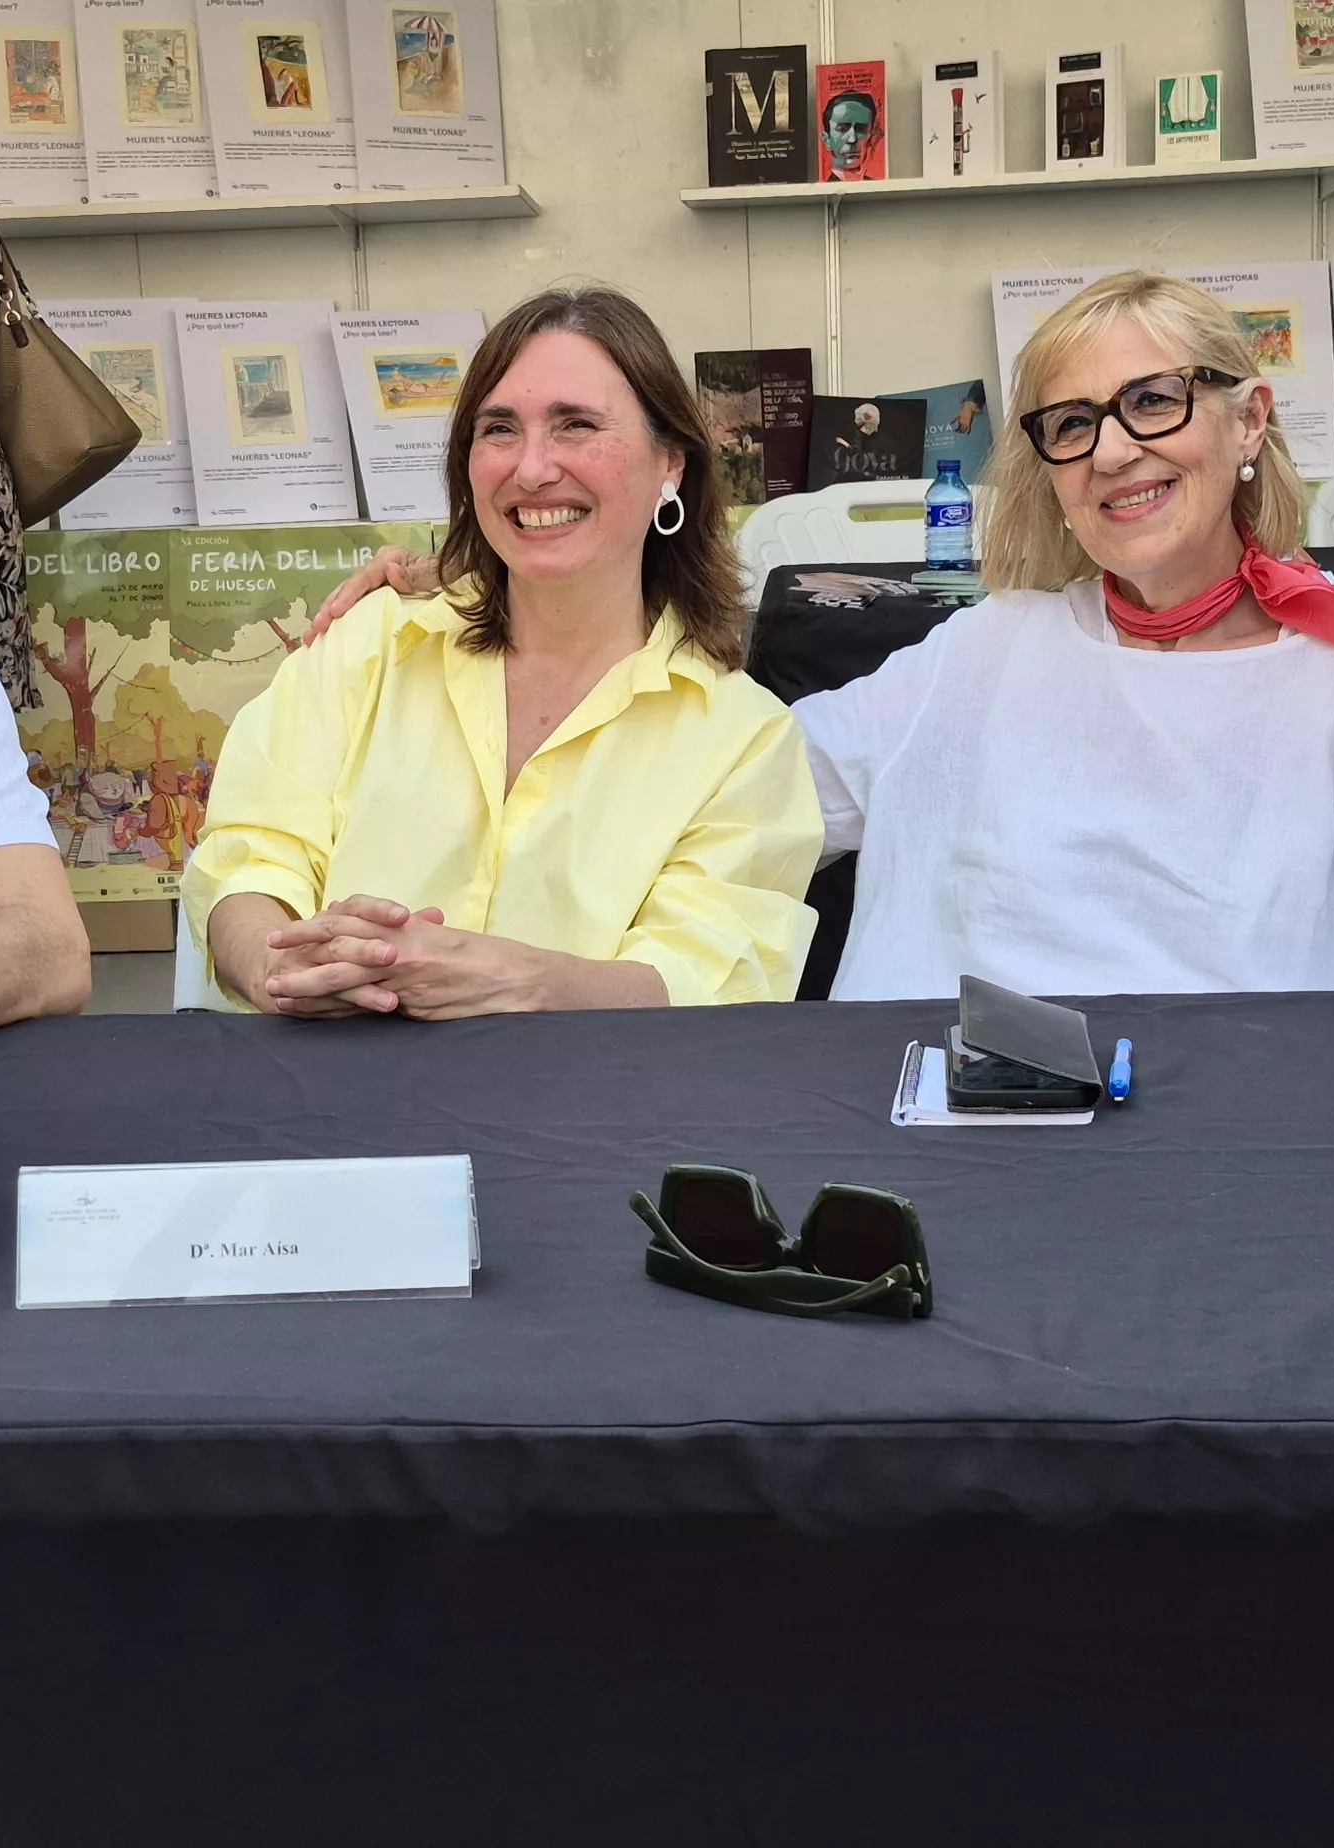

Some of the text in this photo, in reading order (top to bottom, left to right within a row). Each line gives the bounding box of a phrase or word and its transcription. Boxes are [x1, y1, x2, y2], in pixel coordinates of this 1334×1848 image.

[1293, 83, 1331, 92] MUJERES
[725, 70, 795, 135] M
[254, 130, 291, 138] MUJERES
[393, 126, 428, 136] MUJERES
[127, 136, 165, 144] MUJERES
[1002, 278, 1084, 288] MUJERES LECTORAS
[1215, 274, 1259, 283] LECTORAS
[89, 310, 132, 318] LECTORAS
[186, 311, 268, 320] MUJERES LECTORAS
[340, 321, 377, 329] MUJERES
[395, 442, 432, 450] MUJERES
[232, 454, 269, 462] MUJERES
[196, 537, 229, 545] EDICIÓN
[26, 551, 161, 576] DEL LIBRO
[191, 546, 373, 573] FERIA DEL LIB
[190, 578, 276, 592] DE HUESCA
[220, 1242, 258, 1258] Mar
[262, 1240, 299, 1256] Aísa
